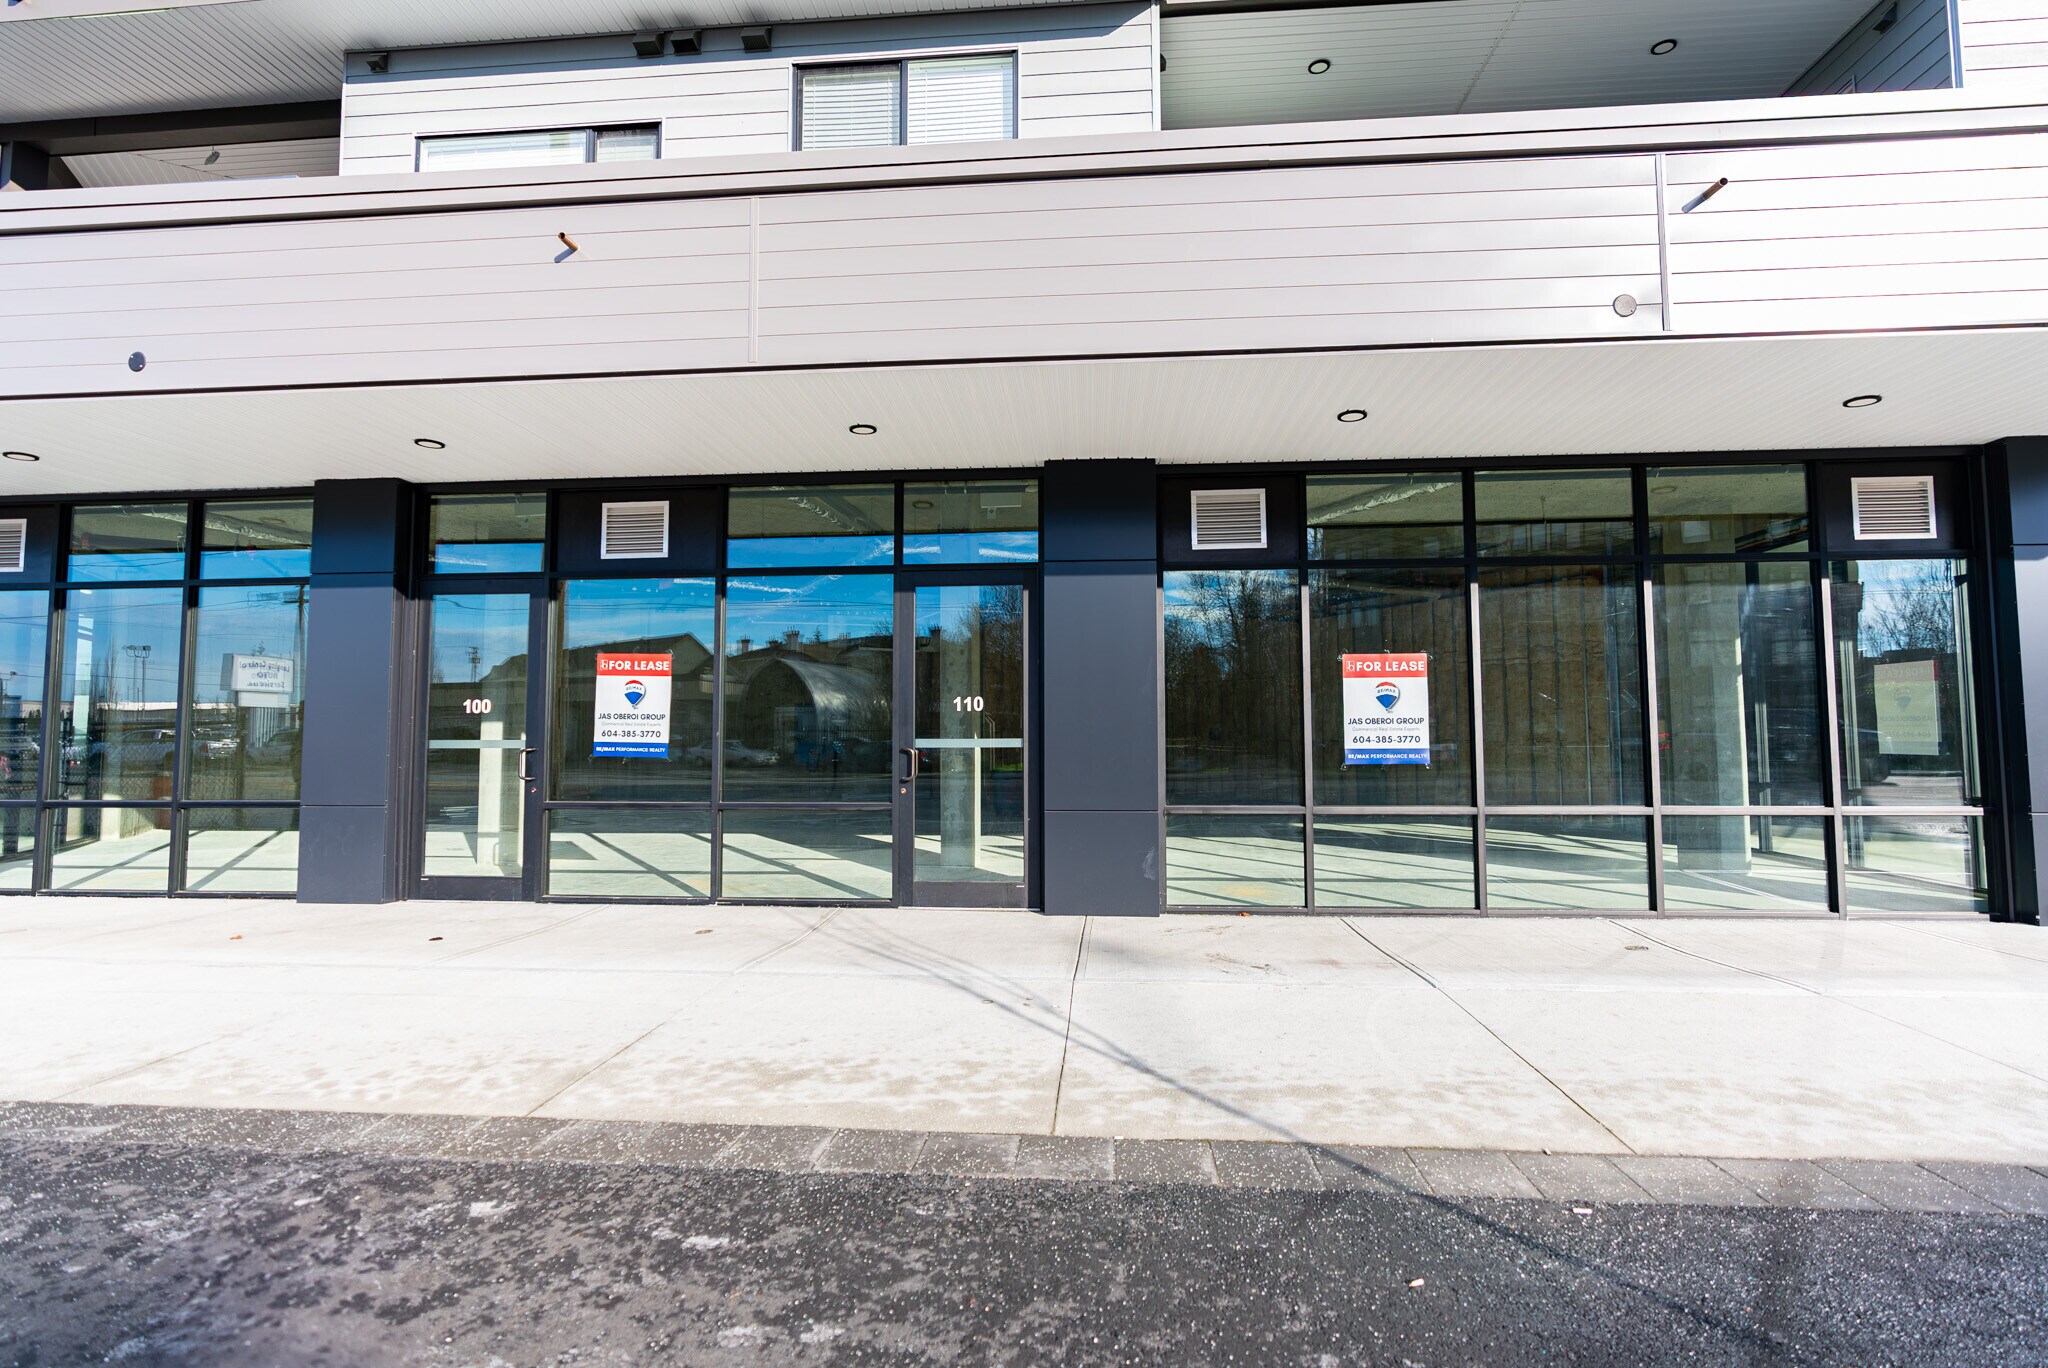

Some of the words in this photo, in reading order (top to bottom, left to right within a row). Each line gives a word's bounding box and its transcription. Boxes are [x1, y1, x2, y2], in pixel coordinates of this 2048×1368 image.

[609, 660, 632, 670] FOR
[634, 660, 670, 670] LEASE
[1356, 661, 1382, 672] FOR
[1385, 661, 1424, 672] LEASE
[463, 699, 492, 714] 100
[954, 696, 984, 711] 110
